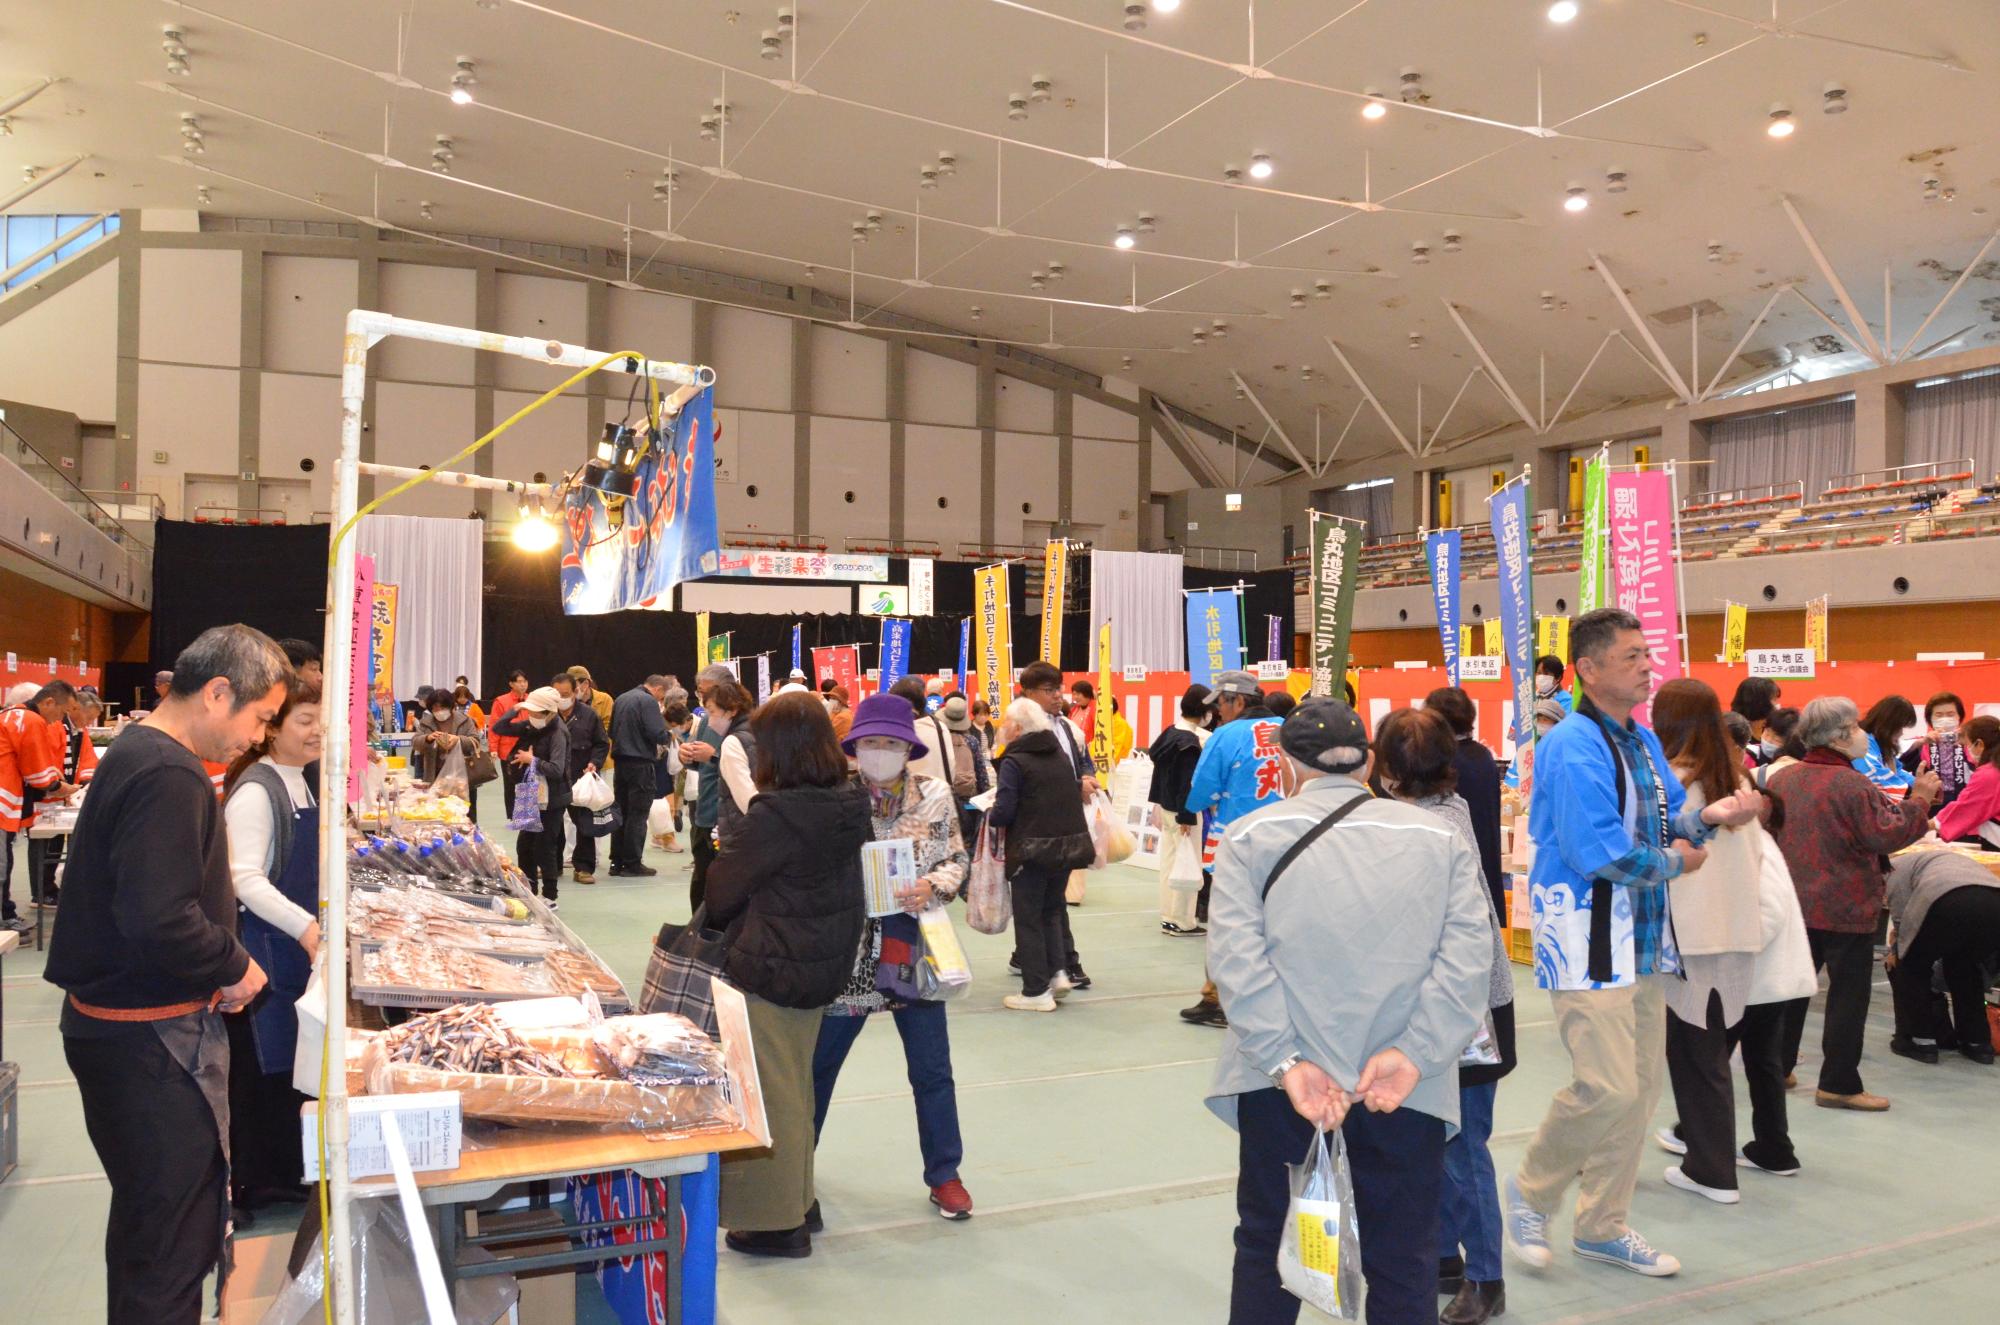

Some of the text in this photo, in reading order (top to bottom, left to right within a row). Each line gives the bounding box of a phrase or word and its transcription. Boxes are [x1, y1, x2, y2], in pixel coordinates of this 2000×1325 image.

[1753, 666, 1808, 674] コミュニティ協議会
